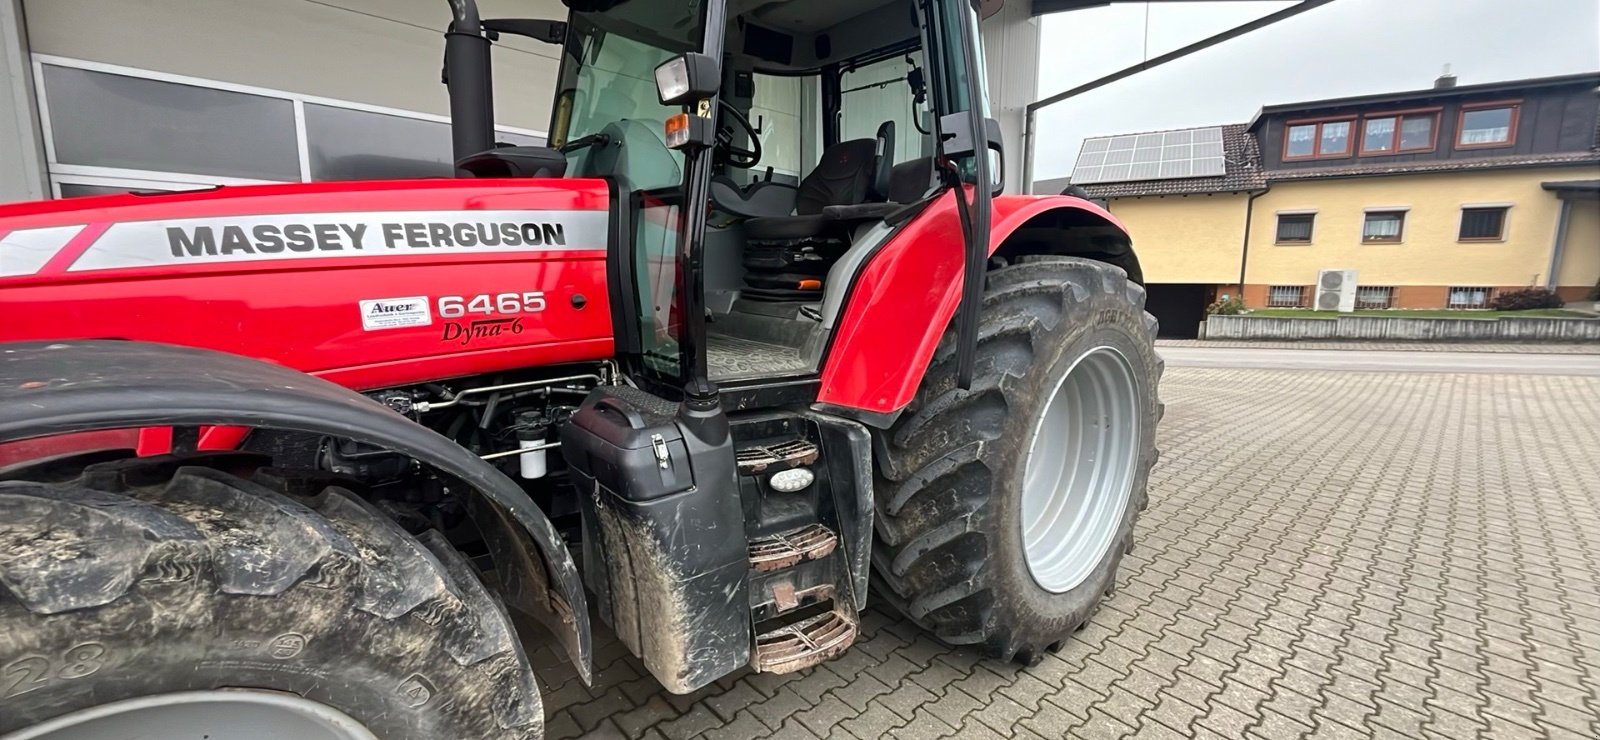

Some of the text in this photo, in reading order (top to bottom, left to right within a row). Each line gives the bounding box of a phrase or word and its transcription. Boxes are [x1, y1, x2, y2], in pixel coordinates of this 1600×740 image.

[166, 222, 565, 258] MASSEY FERGUSON
[371, 302, 415, 314] Auer
[437, 291, 547, 319] 6465
[441, 317, 524, 346] Dyna-6
[3, 640, 106, 700] 28
